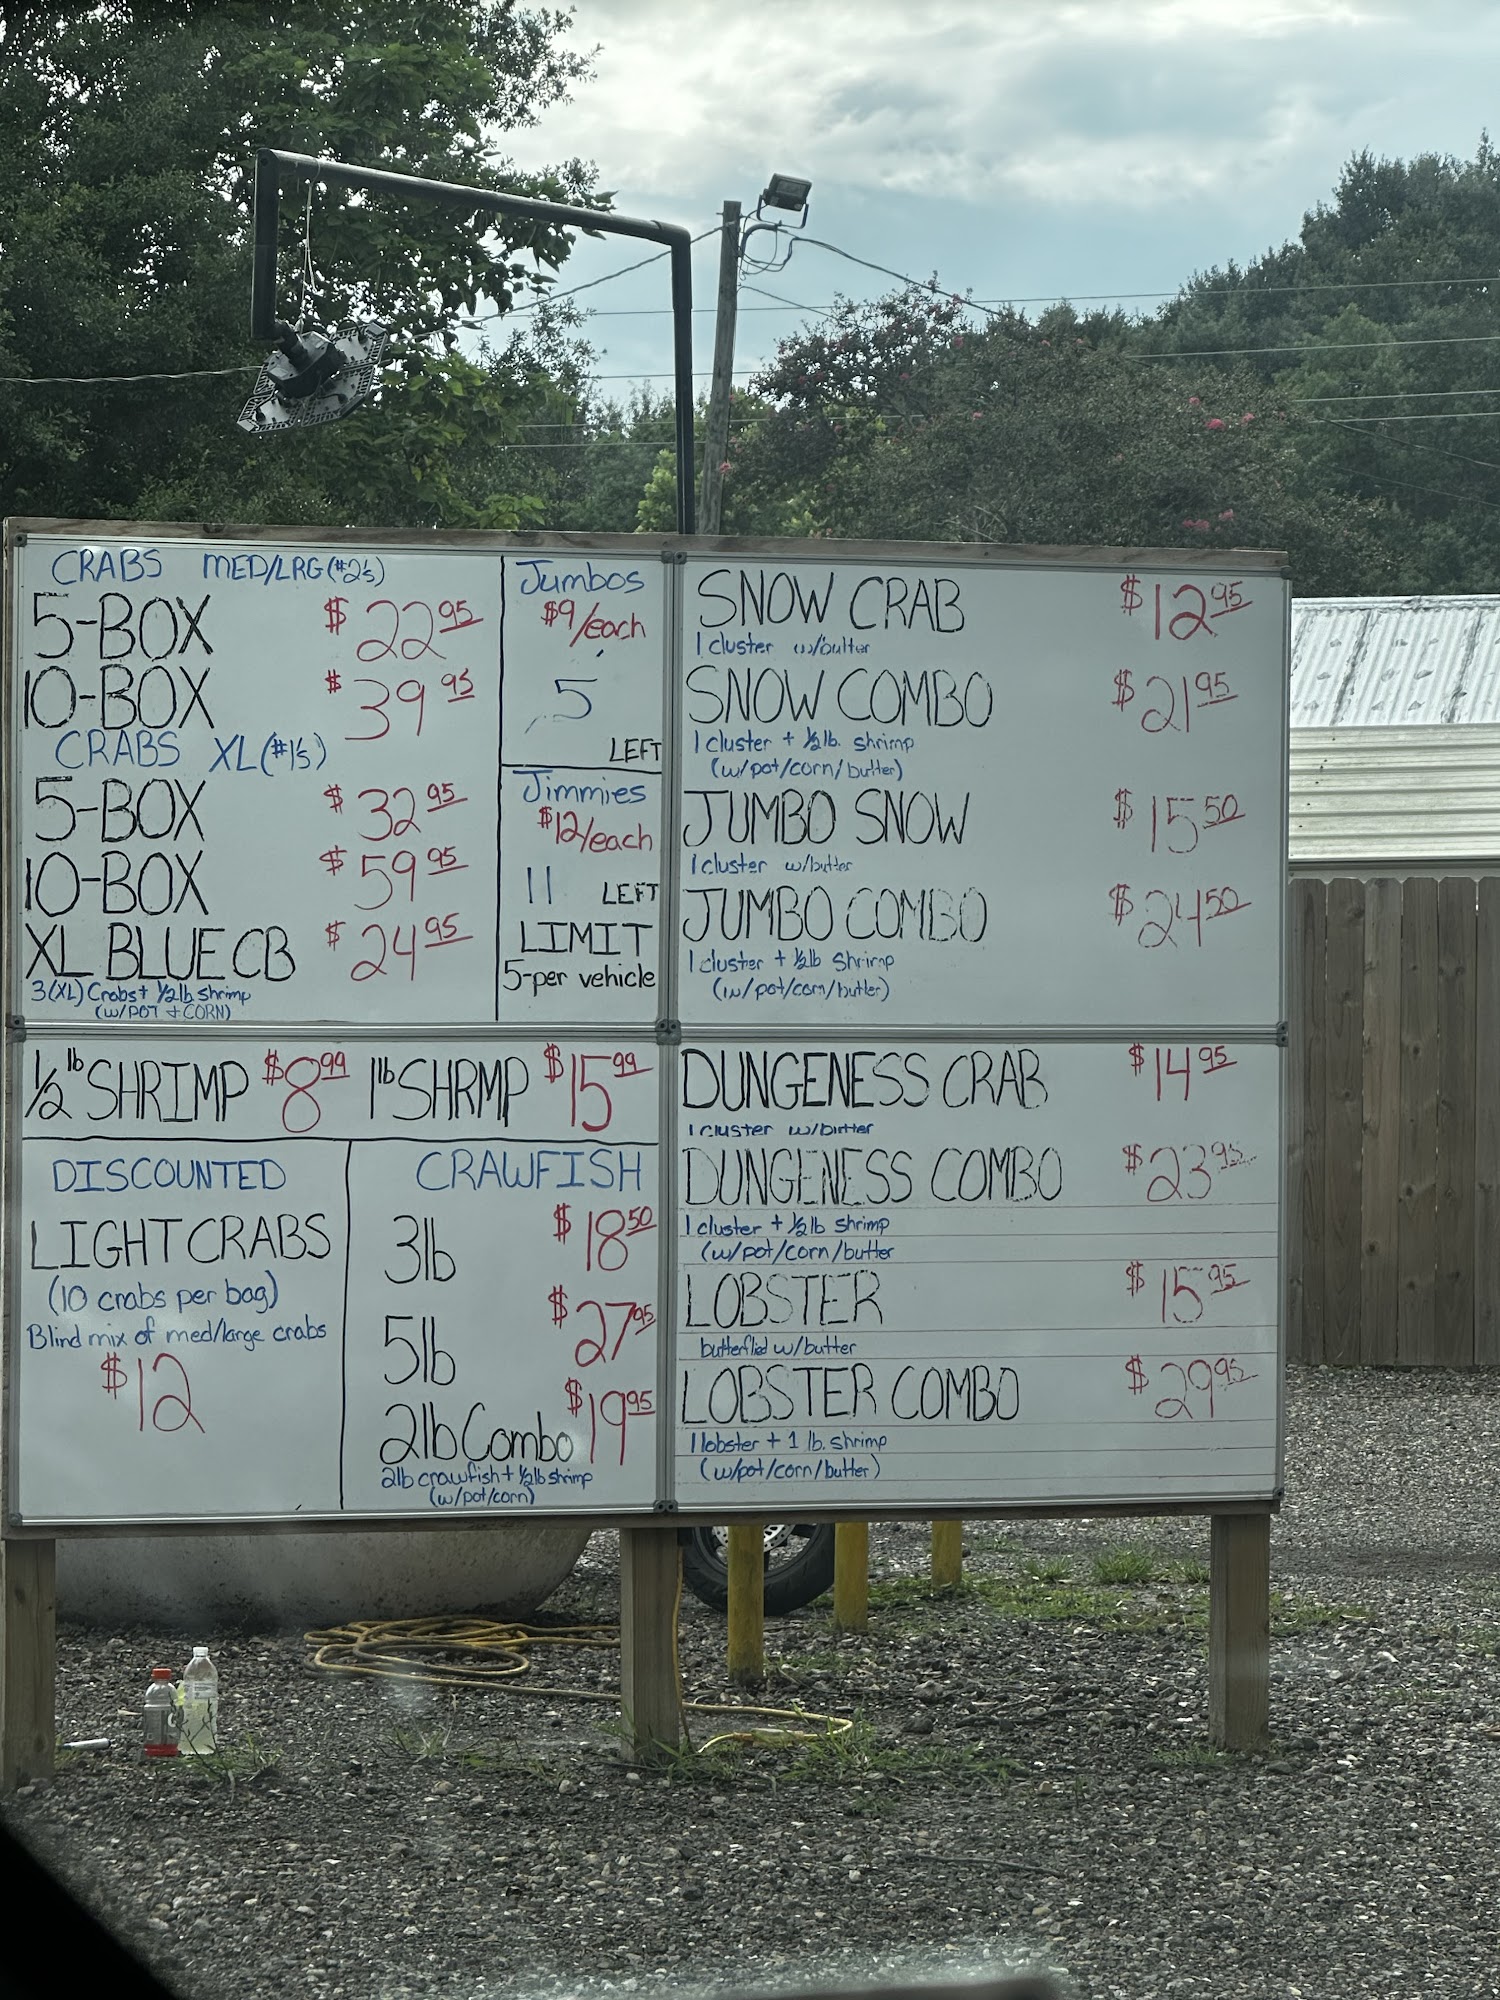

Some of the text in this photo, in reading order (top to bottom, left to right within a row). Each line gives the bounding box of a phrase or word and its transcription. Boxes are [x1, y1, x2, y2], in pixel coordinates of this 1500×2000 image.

[51, 549, 163, 586] CRABS
[516, 560, 645, 595] Jumbos
[697, 568, 965, 632] SNOW CRAB
[33, 592, 214, 661] 5-BOX
[697, 632, 700, 655] 1
[709, 632, 773, 655] cluster
[23, 665, 215, 729] 10-BOX
[552, 678, 598, 719] 5
[686, 665, 993, 727] SNOW COMBO
[55, 729, 181, 769] CRABS
[609, 738, 662, 762] LEFT
[695, 729, 698, 753] 1
[706, 729, 772, 752] cluster
[783, 731, 794, 746] +
[854, 732, 914, 753] shrimp
[512, 769, 647, 806] Jimmies
[35, 776, 206, 842] 5-BOX
[683, 788, 970, 847] JUMBO SNOW
[692, 852, 852, 874] 1 cluster w/butter
[24, 850, 209, 917] 10-BOX
[602, 881, 659, 905] LEFT
[683, 885, 988, 943] JUMBO COMBO
[25, 922, 295, 982] XL BLUE CB
[520, 921, 653, 957] LIMIT
[579, 962, 656, 989] vehicle
[689, 949, 693, 973] 1
[699, 949, 763, 973] cluster
[775, 950, 785, 966] +
[198, 984, 251, 1006] shrimp
[87, 1059, 249, 1122] SHRIMP
[393, 1056, 529, 1128] SHRMP
[681, 1049, 1049, 1112] DUNGENESS CRAB
[700, 1124, 774, 1137] cluster
[52, 1157, 287, 1193] DISCOUNTED
[416, 1148, 642, 1192] CRAWFISH
[682, 1145, 1063, 1206] DUNGENESS COMBO
[31, 1213, 331, 1269] LIGHT CRABS
[686, 1215, 689, 1235] 1
[697, 1215, 762, 1236] cluster
[772, 1214, 782, 1230] +
[835, 1214, 890, 1236] shrimp
[49, 1269, 279, 1316] (10 crabs per bag)
[686, 1269, 883, 1329] LOBSTER
[26, 1314, 327, 1351] Blind mix of med/large crabs
[699, 1336, 857, 1358] butterflied w/butter
[100, 1352, 205, 1434] $12
[682, 1363, 1020, 1425] LOBSTER COMBO
[462, 1402, 574, 1462] Combo
[701, 1432, 760, 1453] lobster
[767, 1433, 781, 1449] +
[789, 1433, 797, 1449] 1
[833, 1432, 887, 1451] shrimp
[418, 1461, 500, 1487] crawfish
[548, 1469, 593, 1490] shrimp
